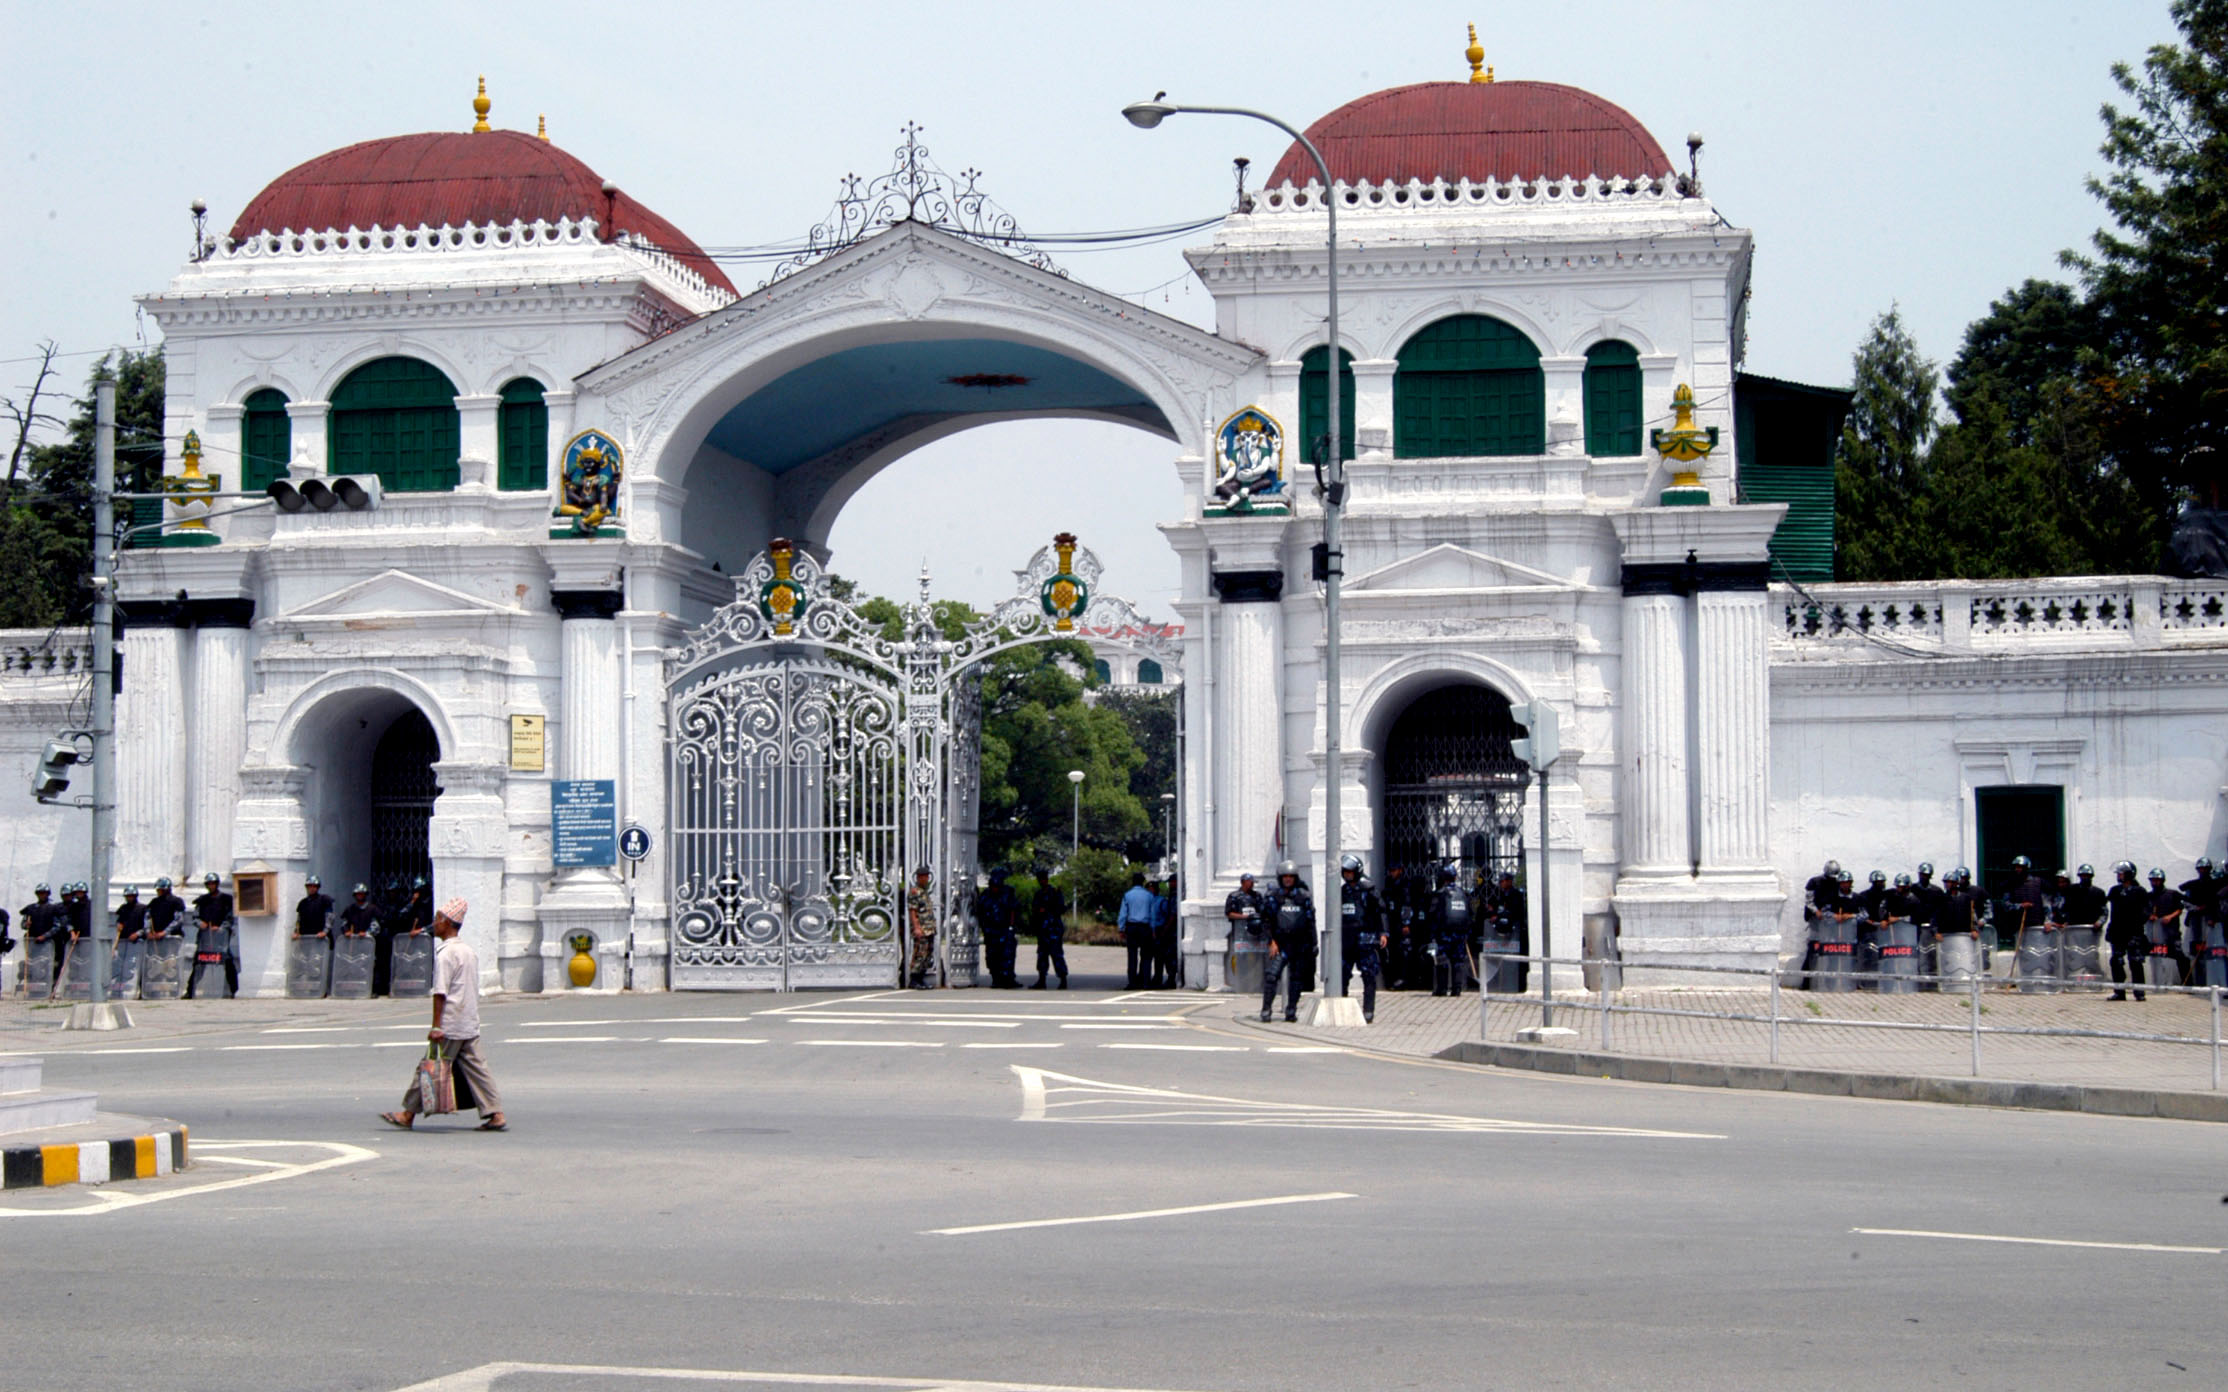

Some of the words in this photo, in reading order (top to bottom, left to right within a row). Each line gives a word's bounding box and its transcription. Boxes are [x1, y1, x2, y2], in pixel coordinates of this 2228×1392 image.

[627, 842, 641, 851] IN
[1823, 943, 1853, 953] POLICE
[1882, 946, 1912, 956] POLICE
